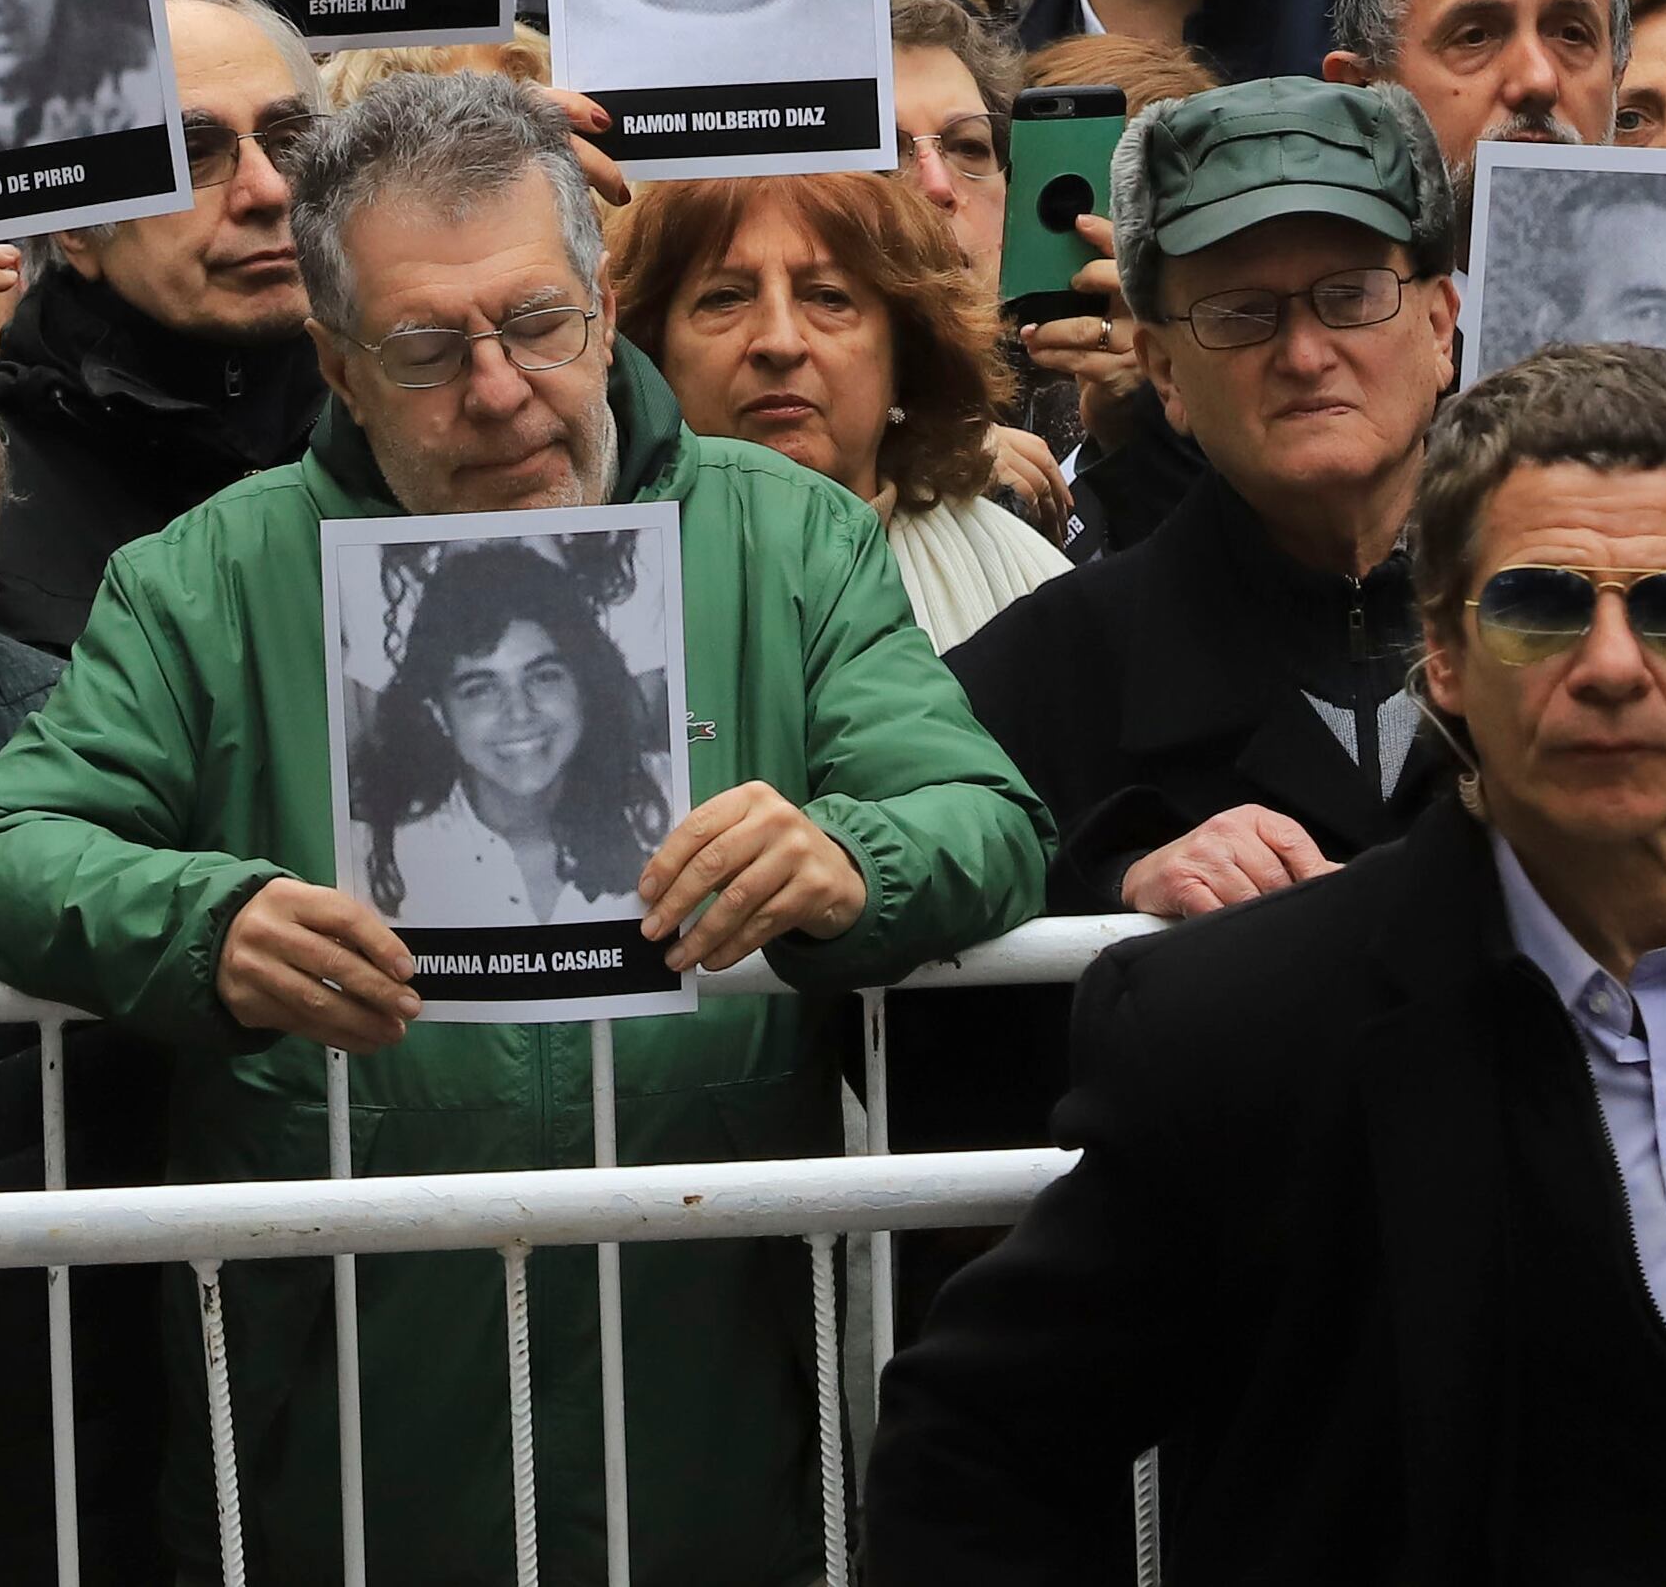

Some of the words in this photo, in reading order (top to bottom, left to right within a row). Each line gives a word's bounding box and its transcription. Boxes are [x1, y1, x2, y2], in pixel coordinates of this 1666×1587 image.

[623, 114, 687, 135] RAMON
[692, 110, 781, 133] NOLBERTO
[786, 107, 826, 127] DIAZ
[6, 173, 31, 194] DE
[33, 164, 85, 190] PIRRO
[412, 955, 484, 975] VIVIANA
[487, 952, 548, 974] ADELA
[551, 949, 623, 973] CASABE
